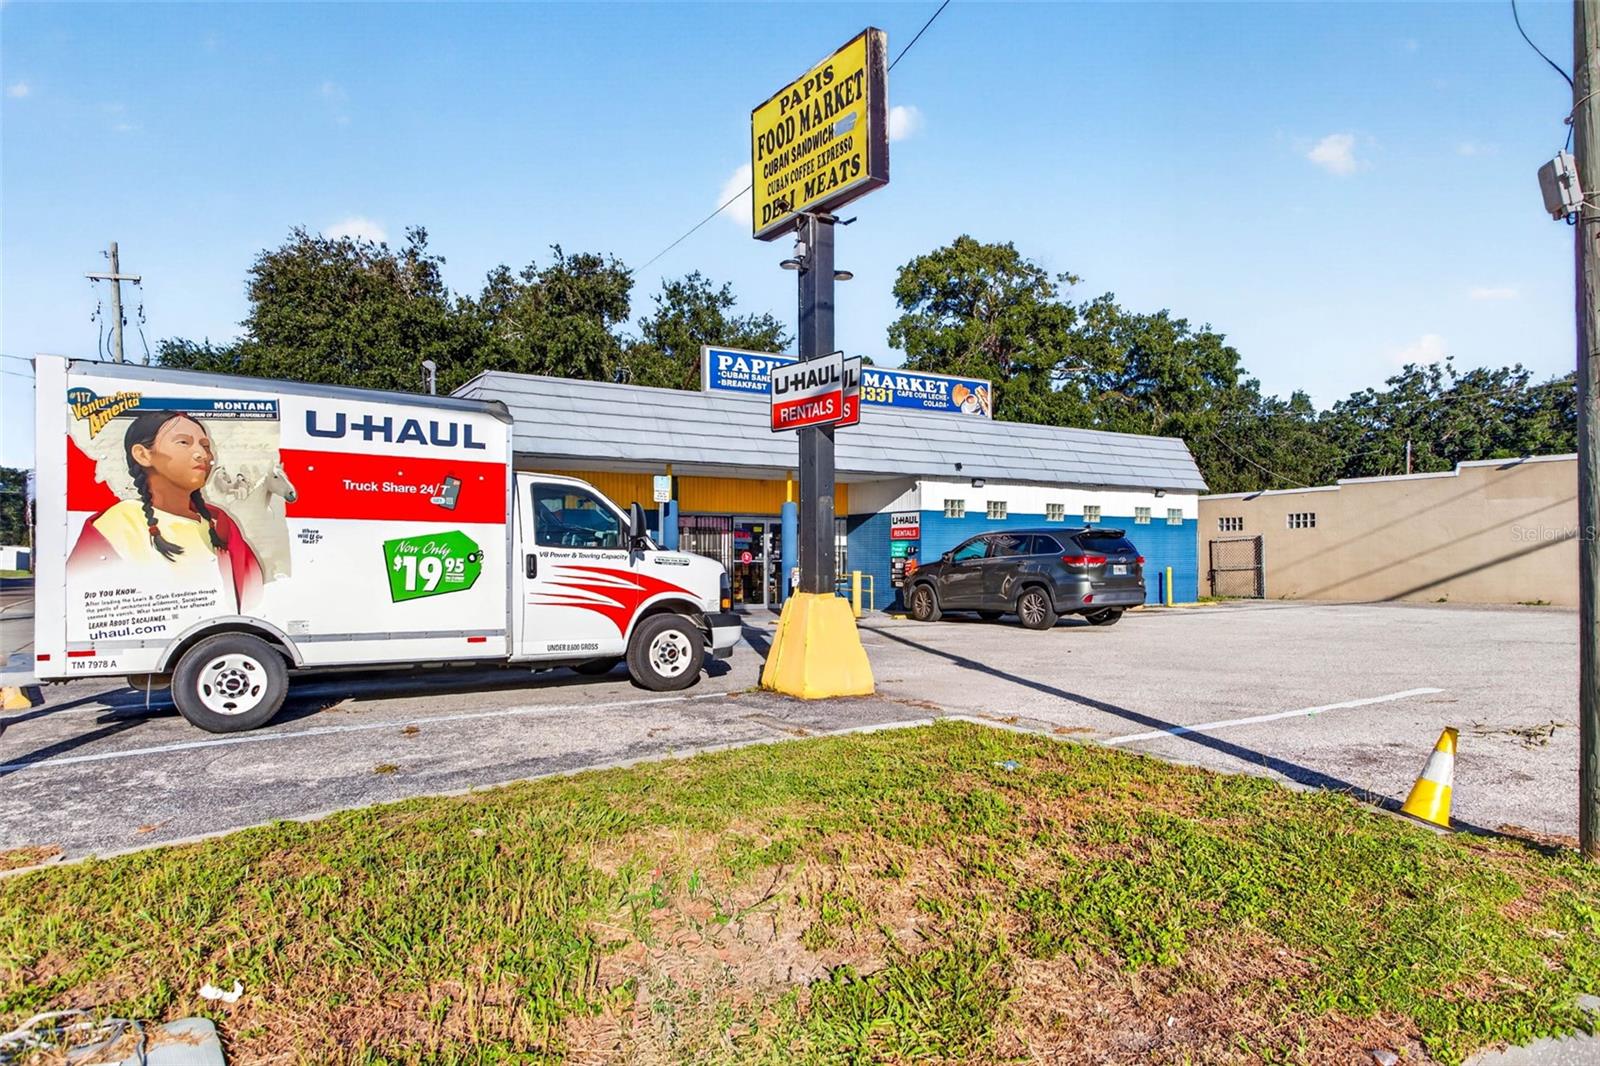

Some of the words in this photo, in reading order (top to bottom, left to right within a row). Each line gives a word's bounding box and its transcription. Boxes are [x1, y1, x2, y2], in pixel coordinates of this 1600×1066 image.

[780, 65, 834, 115] PAPIS
[757, 113, 795, 161] FOOD
[799, 68, 864, 137] MARKET
[763, 152, 789, 179] CUBAN
[791, 122, 834, 162] SANDWICH
[767, 173, 789, 196] CUBAN
[790, 158, 814, 183] COFFEE
[817, 136, 853, 170] EXPRESSO
[803, 153, 860, 202] MEATS
[721, 371, 749, 380] CUBAN
[721, 379, 767, 390] BREAKFAST
[775, 364, 840, 395] U-HAUL
[863, 372, 948, 394] MARKET
[897, 390, 913, 398] CAFE
[914, 391, 927, 399] CON
[72, 396, 116, 421] Venture
[213, 402, 273, 410] MONTANA
[781, 399, 834, 422] RENTALS
[88, 397, 140, 440] America
[306, 410, 486, 449] U-HAUL
[343, 480, 378, 492] Truck
[382, 482, 417, 493] Share
[419, 483, 450, 496] 24/7
[395, 541, 419, 552] Now
[422, 541, 451, 560] Only
[601, 553, 628, 561] Capacity
[88, 622, 107, 630] LEARN
[109, 618, 129, 627] ABOUT
[90, 624, 166, 640] uhaul.com
[581, 643, 599, 651] GROSS
[72, 661, 85, 669] TM
[88, 660, 108, 669] 7978
[111, 660, 117, 668] A
